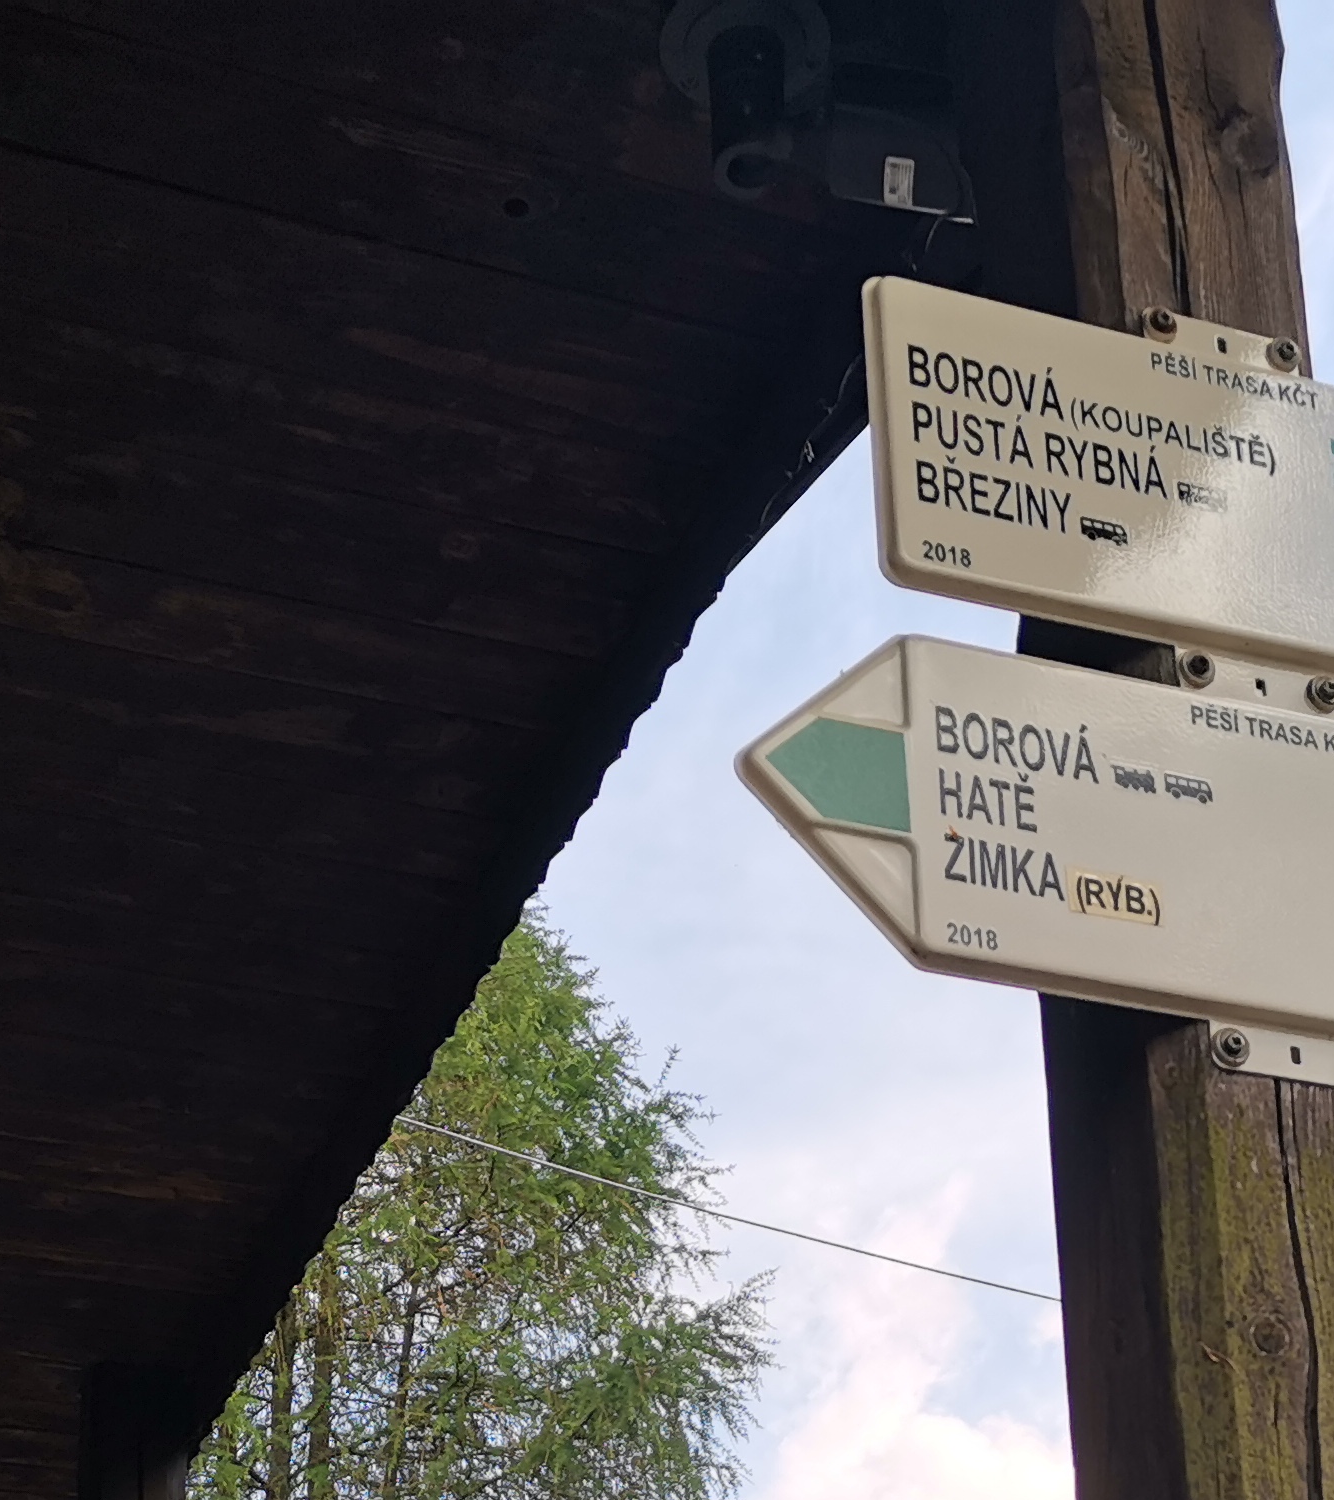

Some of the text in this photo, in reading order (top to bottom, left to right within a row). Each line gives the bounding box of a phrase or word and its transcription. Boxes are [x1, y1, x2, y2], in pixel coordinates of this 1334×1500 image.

[906, 343, 1064, 421] BOROVÁ
[1070, 396, 1277, 477] (KOUPALIŠTĚ)
[1150, 352, 1319, 411] PĚŠÍ TRASA KČT
[910, 400, 1034, 469] PUSTÁ
[1044, 432, 1168, 499] RYBNÁ
[914, 456, 1072, 534] BŘEZINY
[921, 539, 972, 568] 2018
[934, 705, 1100, 785] BOROVÁ
[1190, 703, 1241, 734] PĚŠÍ
[1244, 715, 1319, 750] TRASA
[937, 767, 1038, 834] HATĚ
[946, 922, 999, 951] 2018
